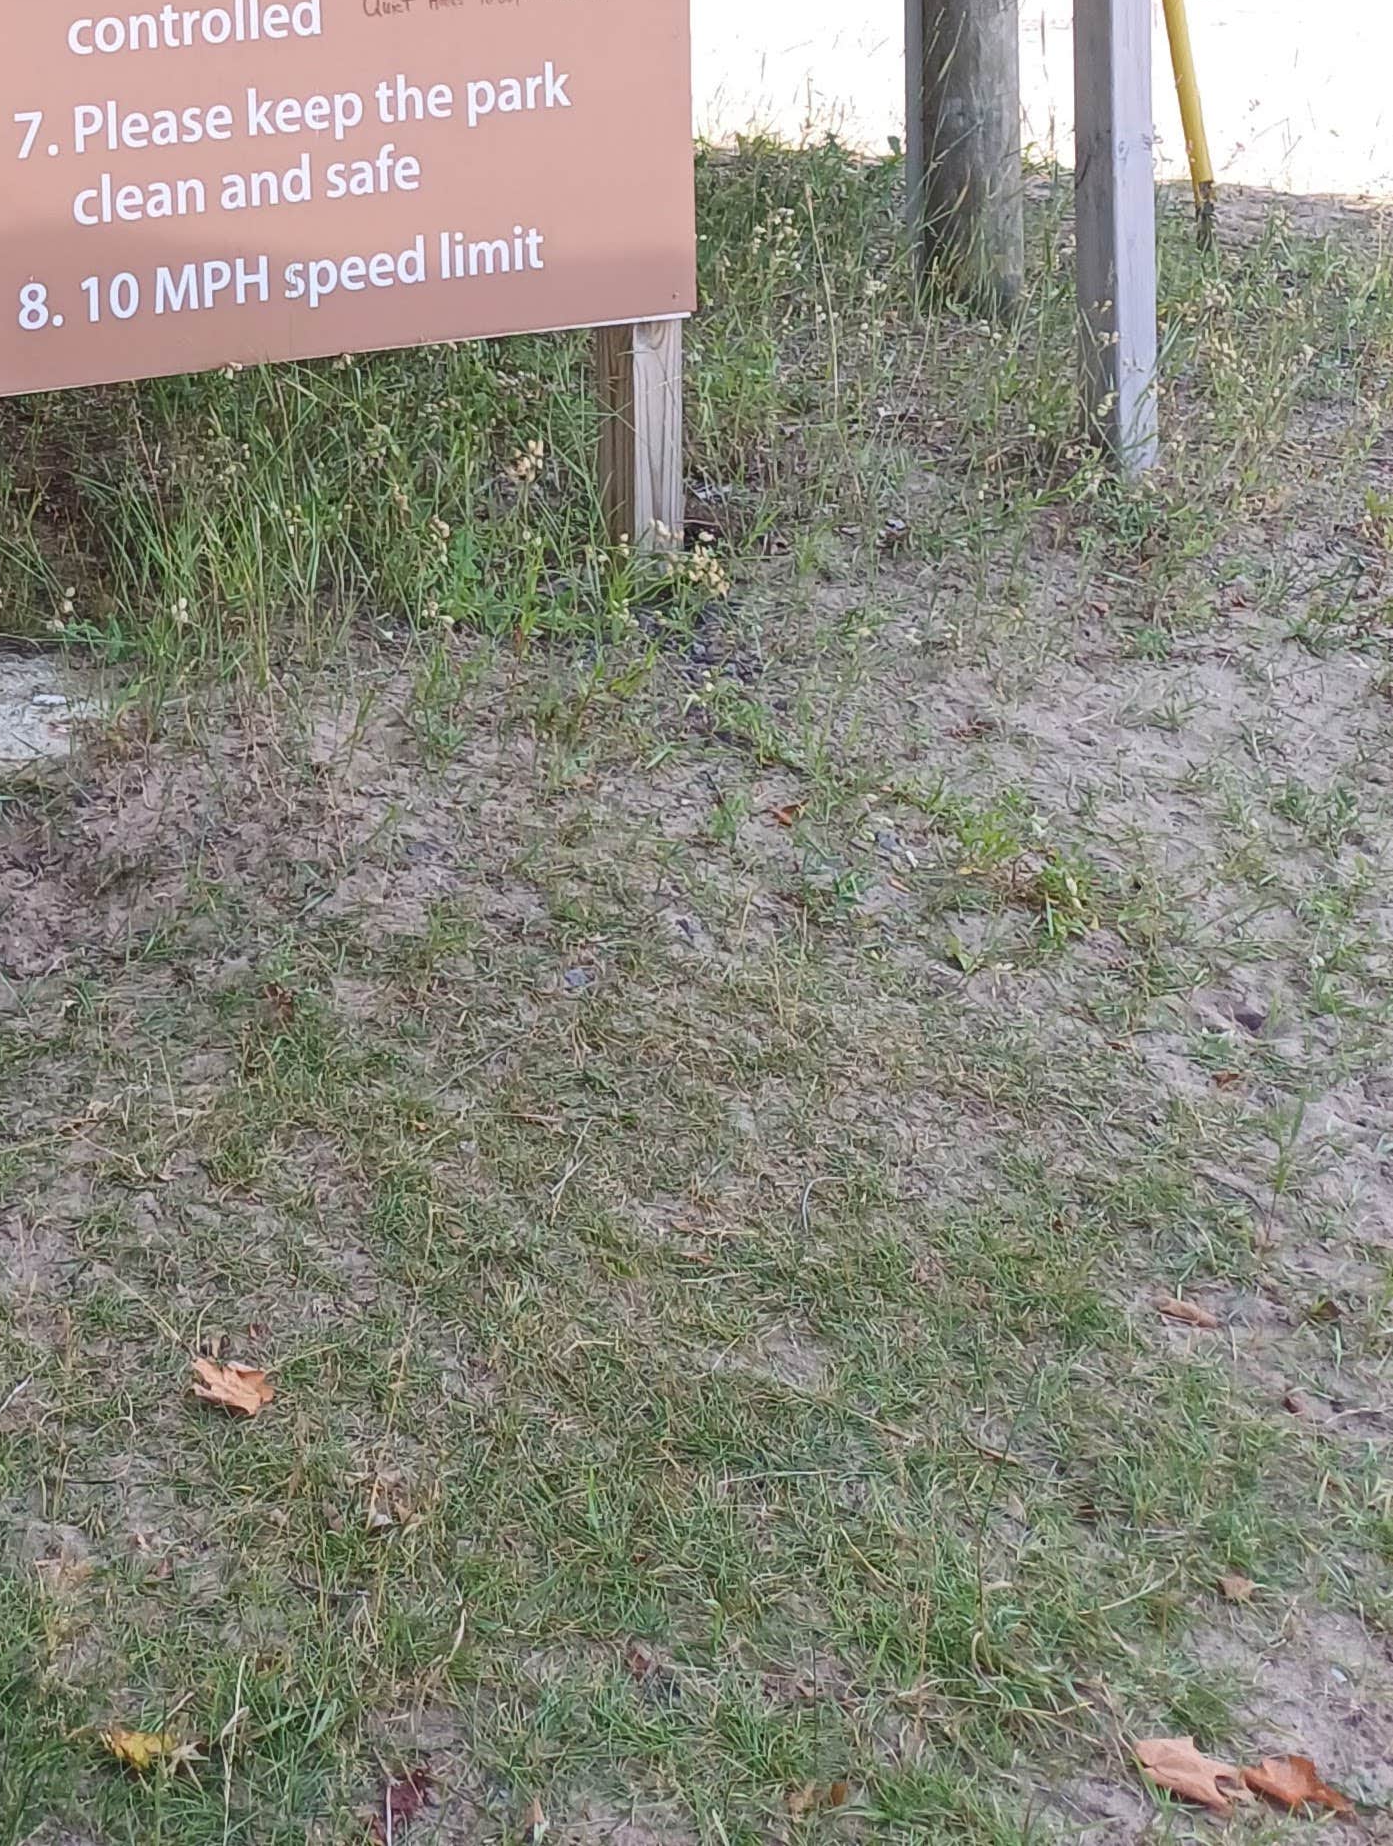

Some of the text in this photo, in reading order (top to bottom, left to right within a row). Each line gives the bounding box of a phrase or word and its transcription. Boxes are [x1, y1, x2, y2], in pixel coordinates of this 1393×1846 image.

[14, 61, 572, 159] 7. Please keep the park
[73, 143, 420, 225] clean and safe
[18, 225, 544, 330] 8. 10 MPH speed limit
